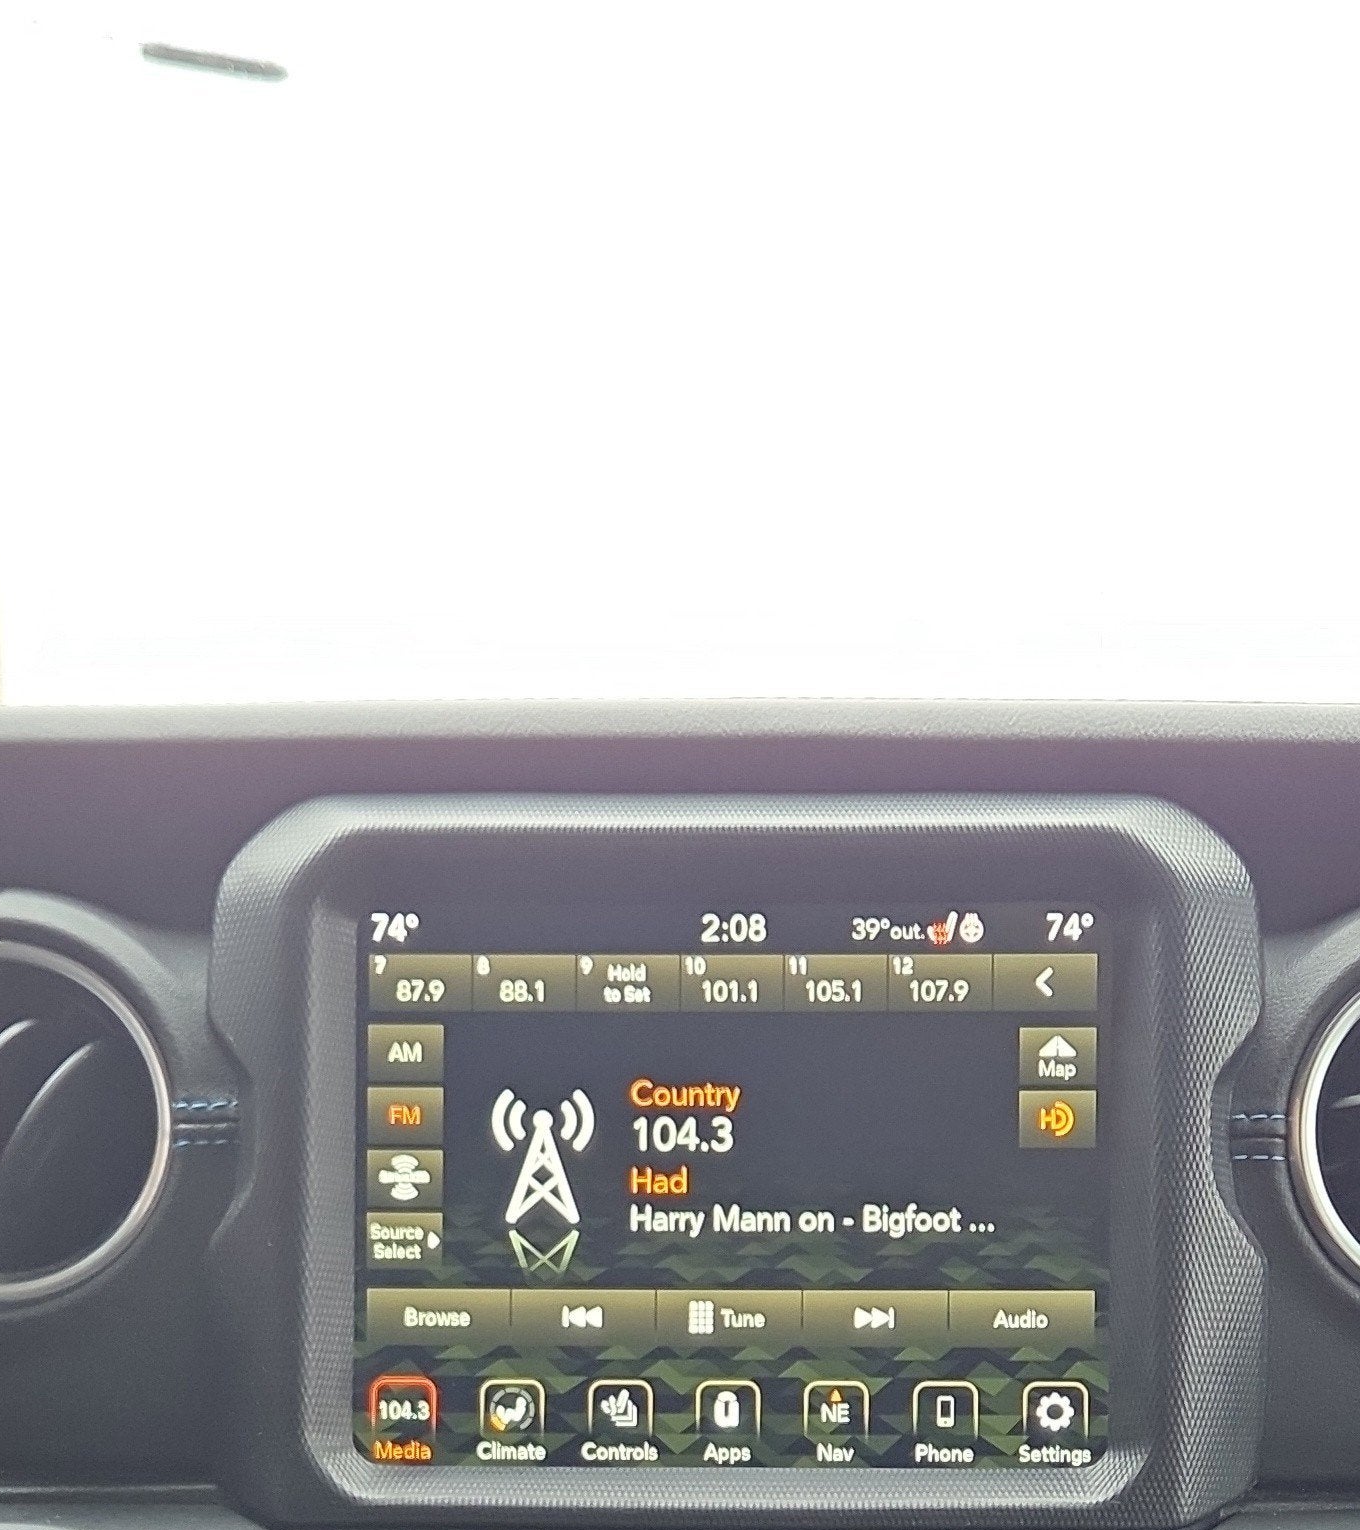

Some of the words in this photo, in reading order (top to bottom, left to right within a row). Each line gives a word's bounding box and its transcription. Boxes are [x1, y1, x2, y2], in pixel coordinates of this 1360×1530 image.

[701, 914, 766, 942] 2:08
[375, 956, 387, 975] 7
[477, 957, 490, 975] 8
[580, 957, 593, 975] 9
[607, 963, 646, 982] Hold
[685, 957, 706, 975] 10
[788, 957, 808, 975] 11
[892, 957, 913, 975] 12
[396, 979, 444, 1002] 87.9
[500, 980, 545, 1002] 88.1
[604, 986, 621, 1003] to
[702, 980, 758, 1002] 101.1
[806, 980, 861, 1002] 105.1
[910, 980, 969, 1002] 107.9
[388, 1042, 423, 1063] AM
[1038, 1059, 1076, 1081] Map
[630, 1080, 740, 1112] Country
[388, 1104, 422, 1125] FM
[633, 1116, 734, 1152] 104.3
[630, 1166, 688, 1194] Had
[629, 1203, 706, 1238] Harry
[713, 1203, 791, 1233] Mann
[799, 1211, 835, 1233] on
[862, 1202, 962, 1239] Bigfoot
[370, 1223, 424, 1241] Source
[373, 1242, 422, 1260] Select
[403, 1306, 471, 1327] Browse
[720, 1308, 766, 1328] Tune
[993, 1309, 1049, 1329] Audio
[379, 1400, 430, 1421] 104.3
[821, 1403, 850, 1424] NE
[373, 1440, 432, 1460] Media
[476, 1441, 546, 1461] Climate
[581, 1442, 658, 1461] Controls
[703, 1443, 751, 1464] Apps
[817, 1443, 855, 1462] Nav
[915, 1443, 974, 1463] Phone
[1019, 1444, 1092, 1466] Settings
